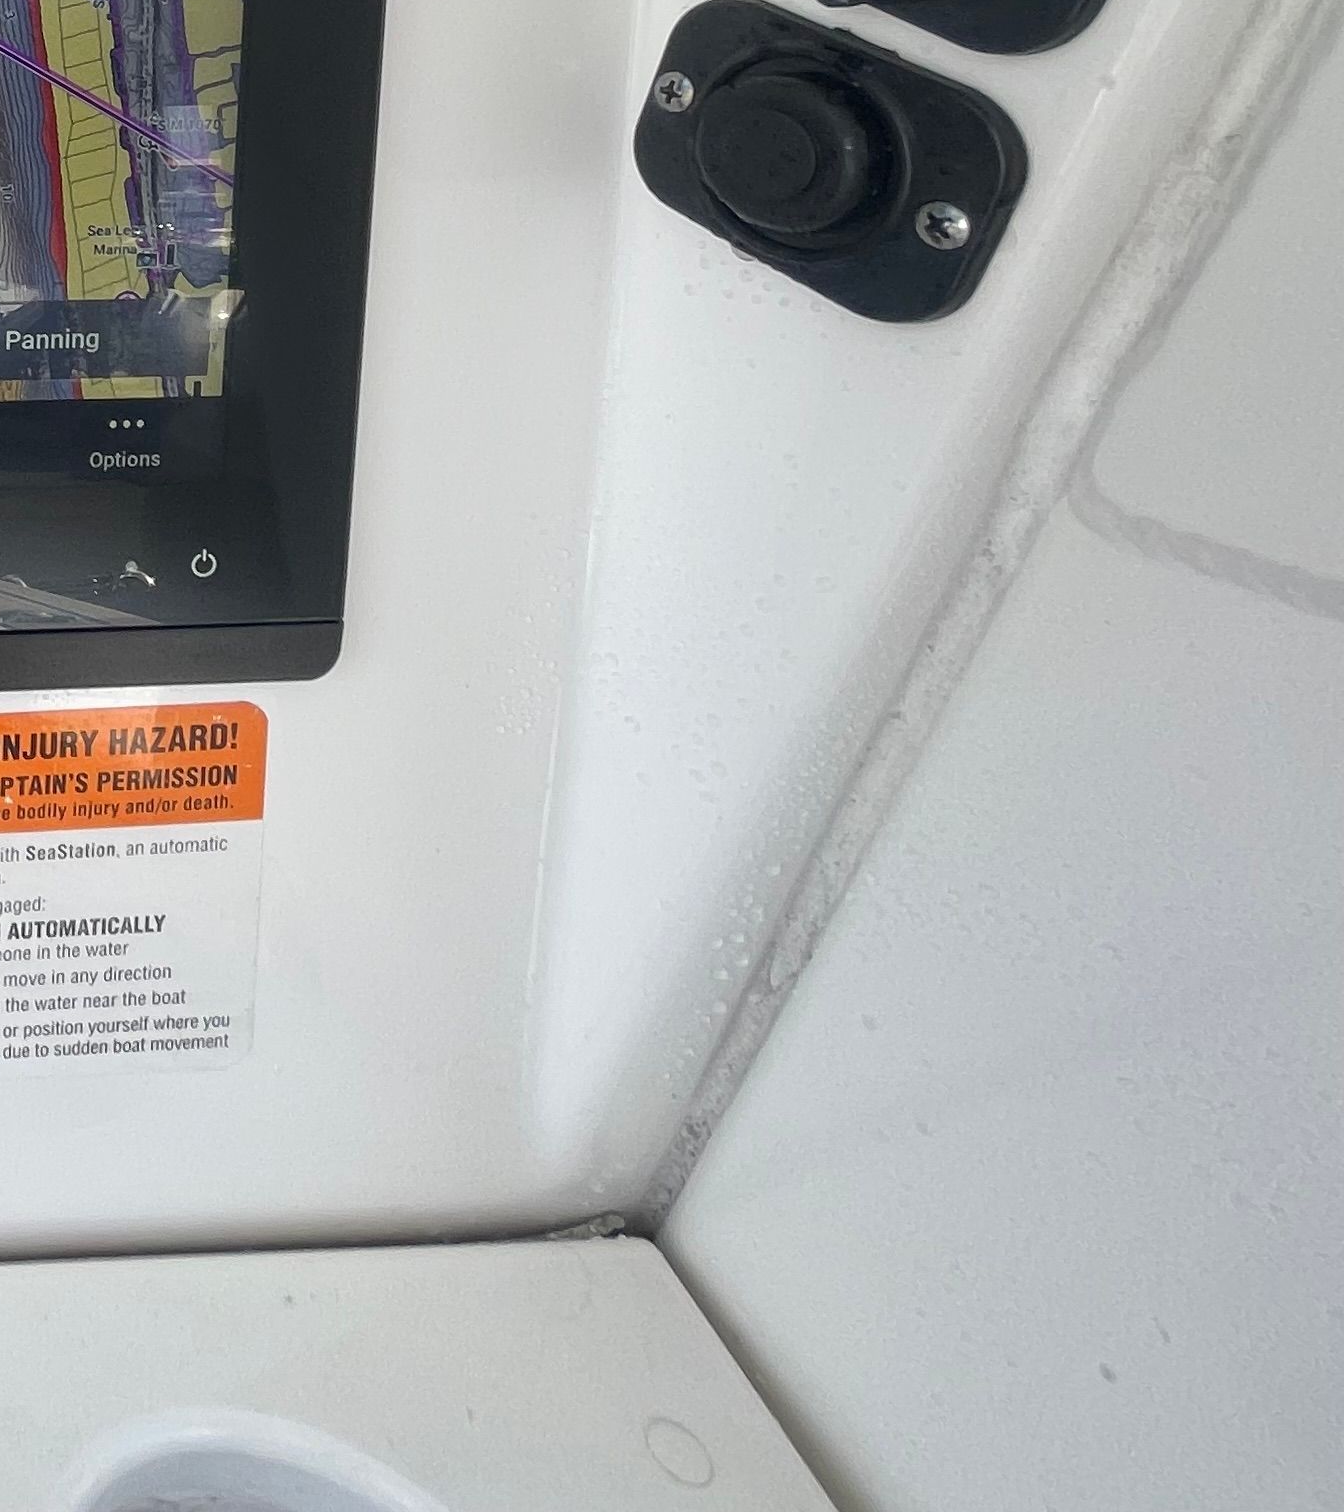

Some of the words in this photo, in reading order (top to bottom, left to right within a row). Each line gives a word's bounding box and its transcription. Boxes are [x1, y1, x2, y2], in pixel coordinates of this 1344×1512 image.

[0, 184, 12, 203] 10
[5, 329, 100, 353] Panning
[89, 451, 161, 472] Options
[109, 722, 239, 756] HAZARD!
[97, 764, 238, 793] PERMISSION
[17, 802, 67, 822] bodily
[72, 799, 120, 821] injury
[125, 795, 178, 815] and/or
[183, 794, 235, 813] death.
[25, 842, 121, 862] SeaStation,
[126, 842, 145, 857] an
[149, 835, 229, 856] automatic
[7, 914, 166, 940] AUTOMATICALLY
[36, 944, 51, 960] in
[56, 942, 81, 959] the
[85, 942, 130, 958] water
[3, 971, 47, 988] move
[51, 969, 65, 985] in
[70, 969, 99, 986] any
[103, 964, 172, 983] direction
[5, 996, 30, 1013] the
[34, 995, 78, 1012] water
[82, 992, 119, 1009] near
[122, 990, 147, 1007] the
[151, 989, 187, 1006] boat
[2, 1024, 19, 1038] or
[23, 1018, 84, 1039] position
[88, 1015, 150, 1037] yourself
[153, 1013, 199, 1031] where
[202, 1014, 231, 1032] you
[3, 1043, 31, 1061] due
[35, 1042, 50, 1058] to
[54, 1038, 108, 1057] sudden
[113, 1036, 147, 1054] boat
[150, 1033, 230, 1052] movement
